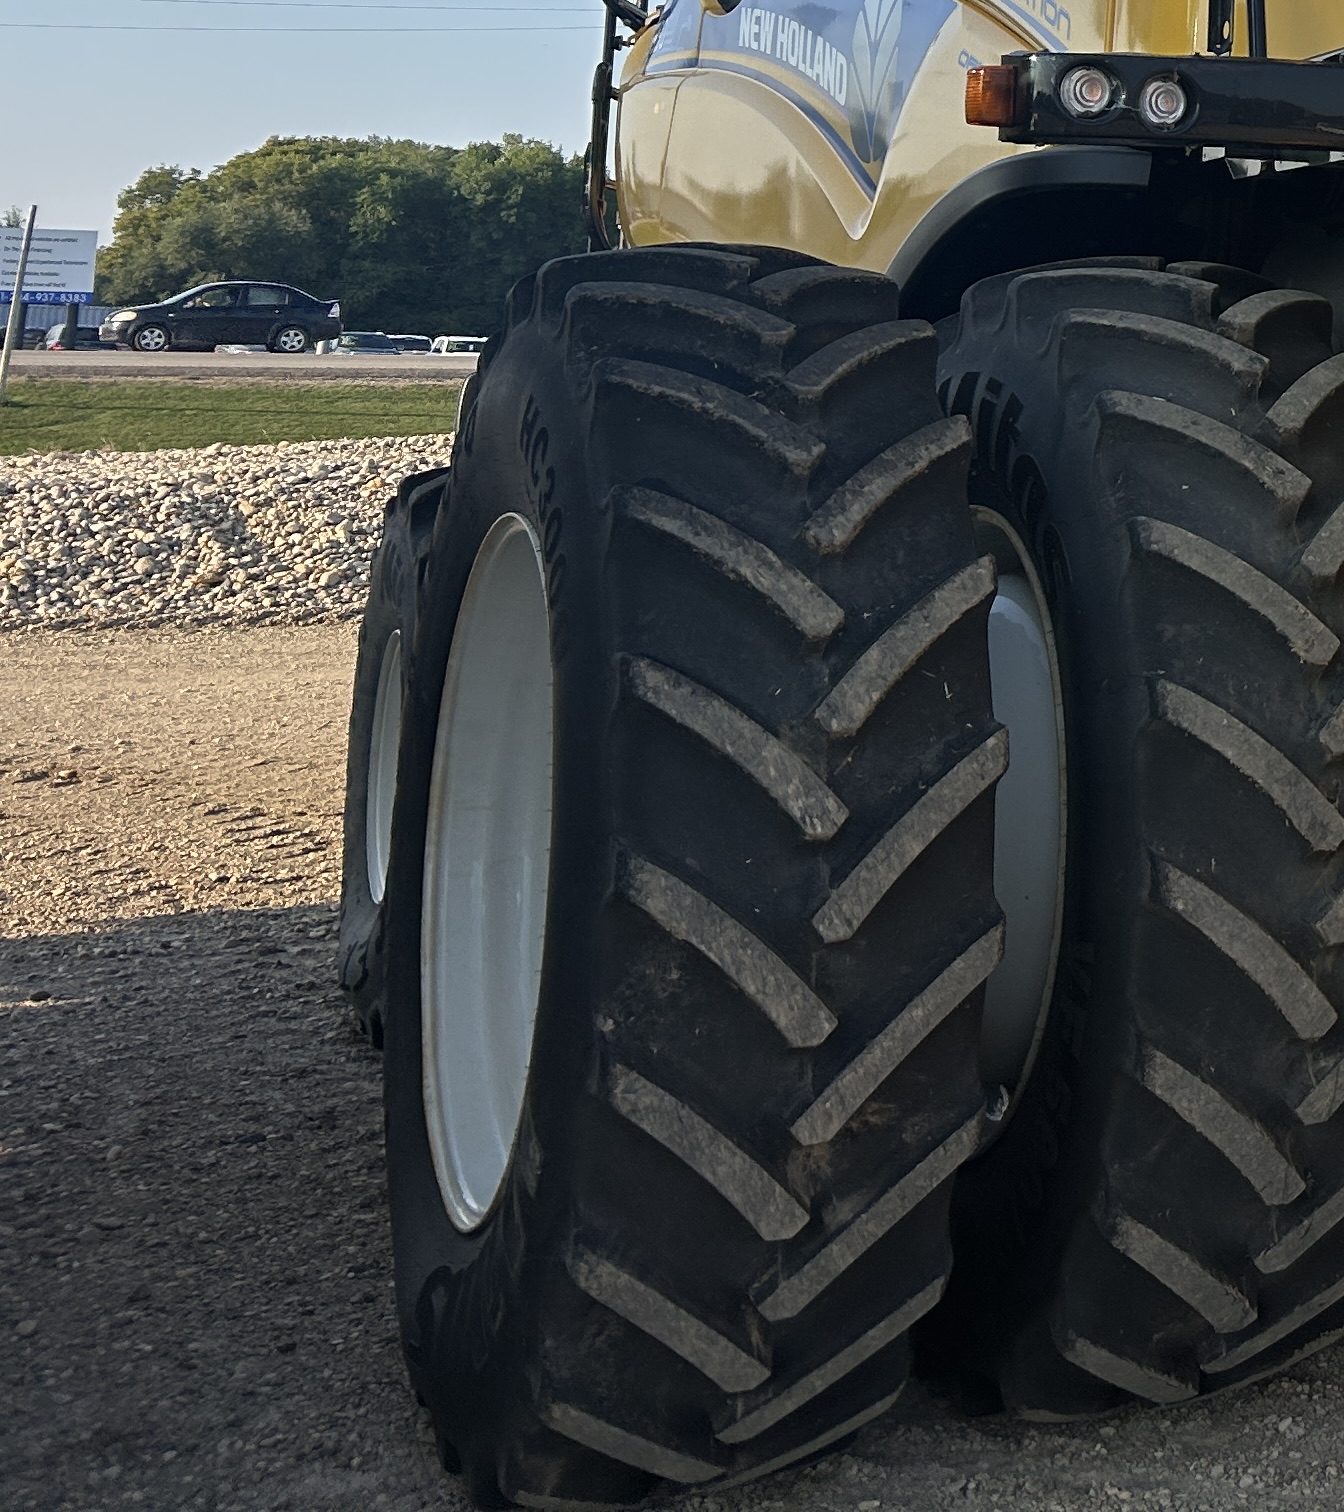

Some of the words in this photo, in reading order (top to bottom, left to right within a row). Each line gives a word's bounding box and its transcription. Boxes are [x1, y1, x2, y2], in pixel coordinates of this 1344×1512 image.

[738, 6, 776, 55] NEW
[775, 14, 848, 106] HOLLAND
[0, 292, 87, 303] 1-24-937-8383
